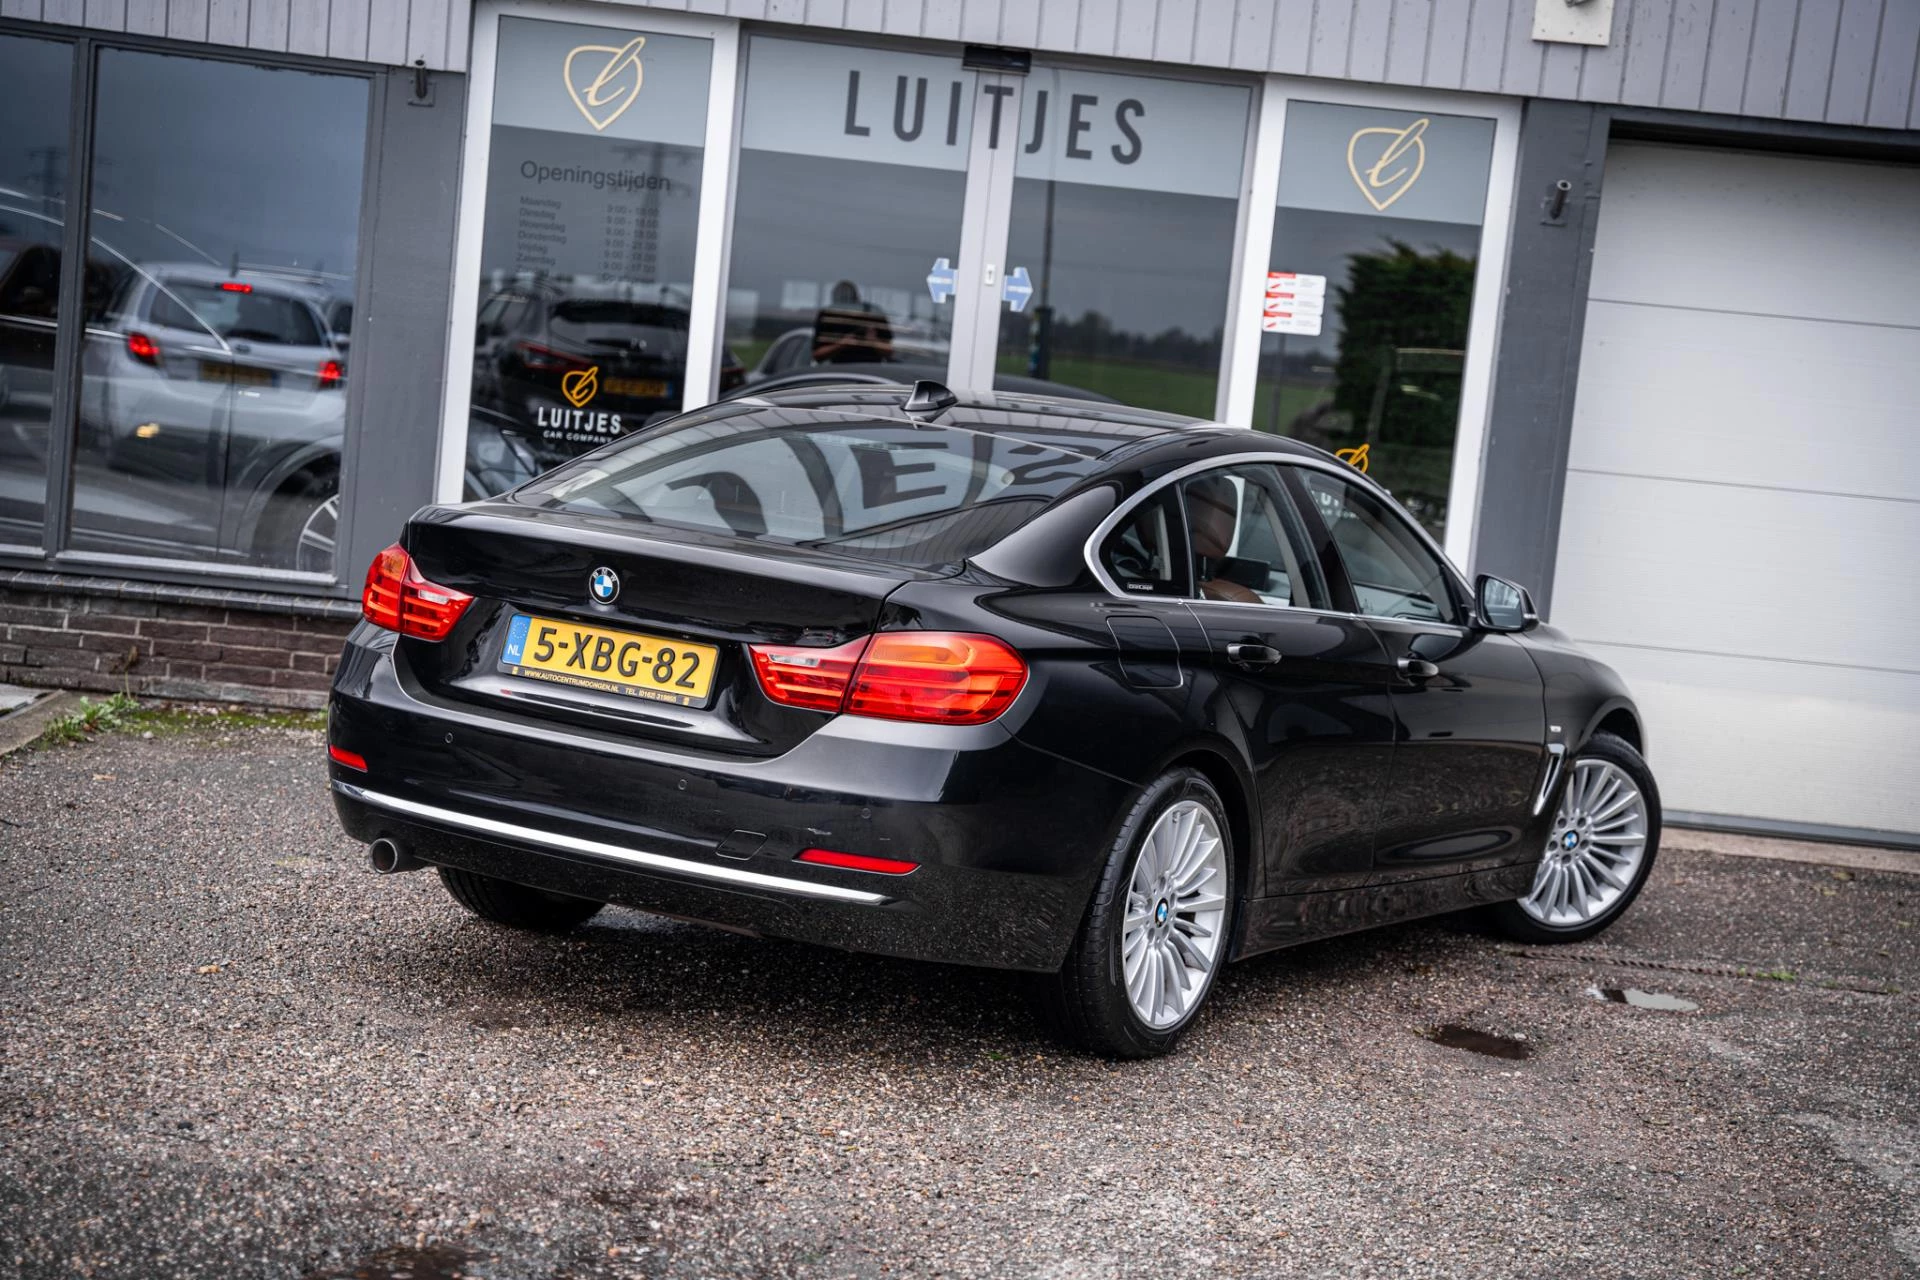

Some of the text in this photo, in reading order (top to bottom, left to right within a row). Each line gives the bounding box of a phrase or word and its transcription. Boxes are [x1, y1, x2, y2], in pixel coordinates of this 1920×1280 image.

[844, 70, 1145, 165] LUITJES
[520, 160, 671, 192] Openingstijden
[520, 195, 562, 209] Maandag
[518, 230, 567, 245] Donderdag
[537, 406, 622, 435] LUITJES
[543, 430, 613, 444] CAR COMPANY
[507, 644, 521, 656] NL
[534, 626, 700, 688] 5-XBG-82
